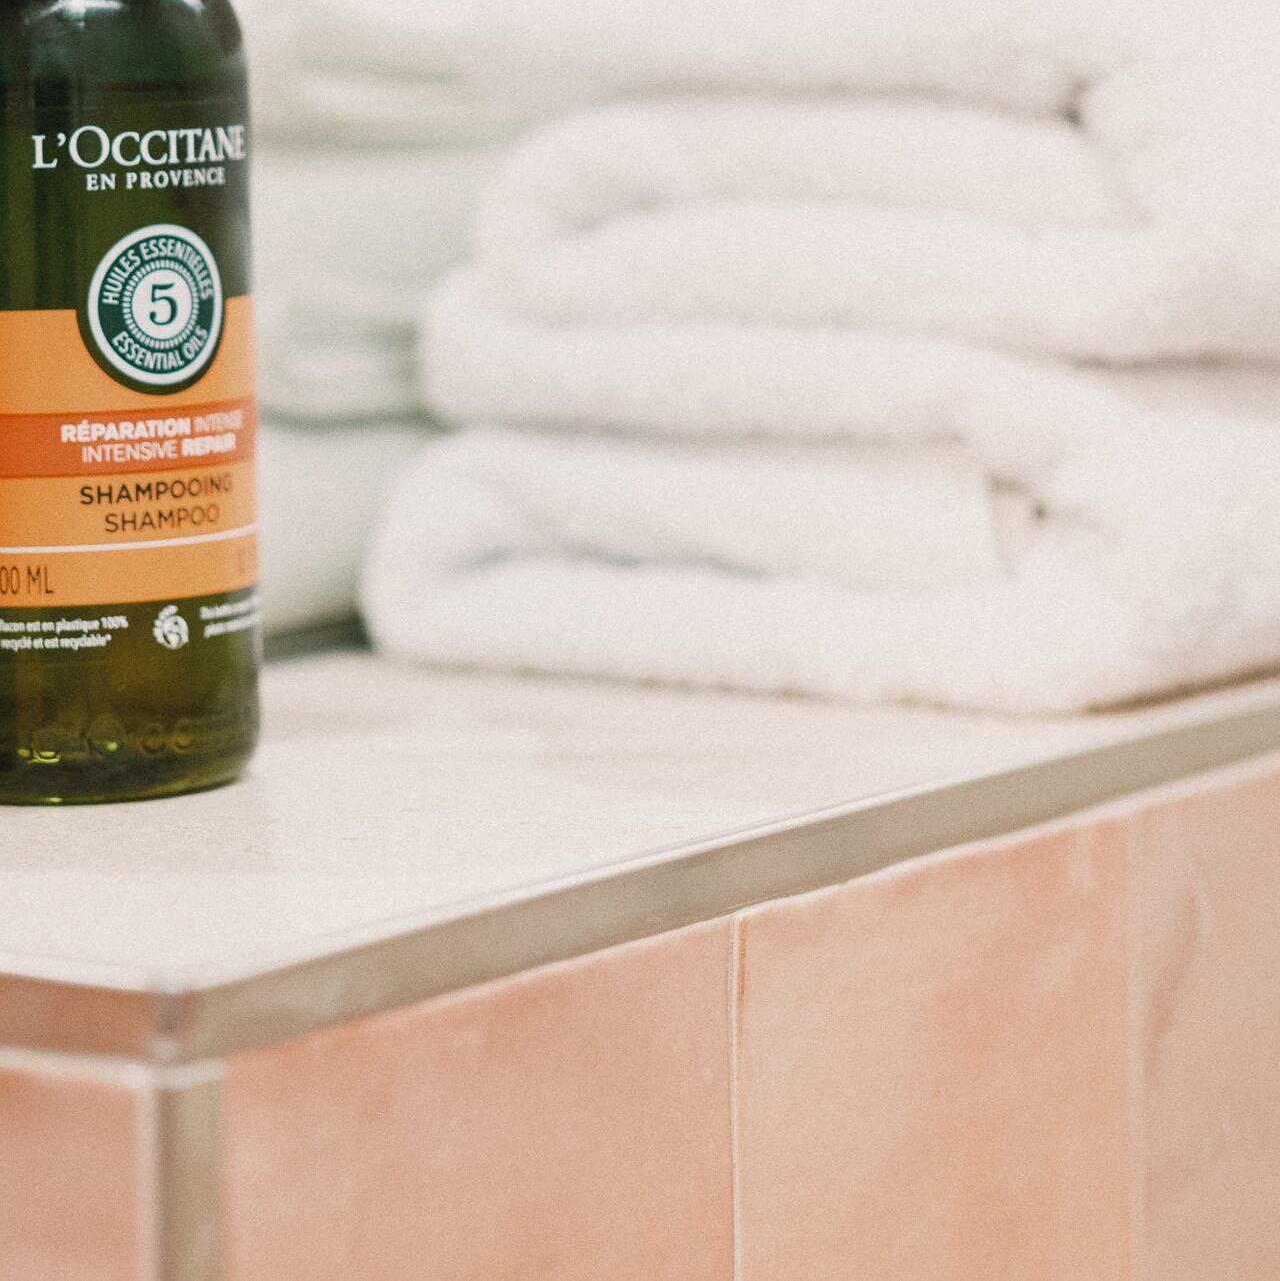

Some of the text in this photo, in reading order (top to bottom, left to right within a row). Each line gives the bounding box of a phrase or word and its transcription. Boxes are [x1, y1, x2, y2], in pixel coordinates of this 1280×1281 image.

[31, 125, 246, 168] L'OCCITANE
[86, 167, 226, 191] EN PROVENCE
[102, 238, 213, 305] HUILES ESSENTIELLES
[149, 282, 178, 325] 5
[112, 326, 208, 370] ESSENTIAL OILS
[60, 417, 191, 443] RÉPARATION
[81, 432, 236, 464] INTENSIVE REPAIR
[79, 472, 234, 506] SHAMPOOING
[104, 503, 220, 533] SHAMPOO
[27, 565, 56, 594] ML
